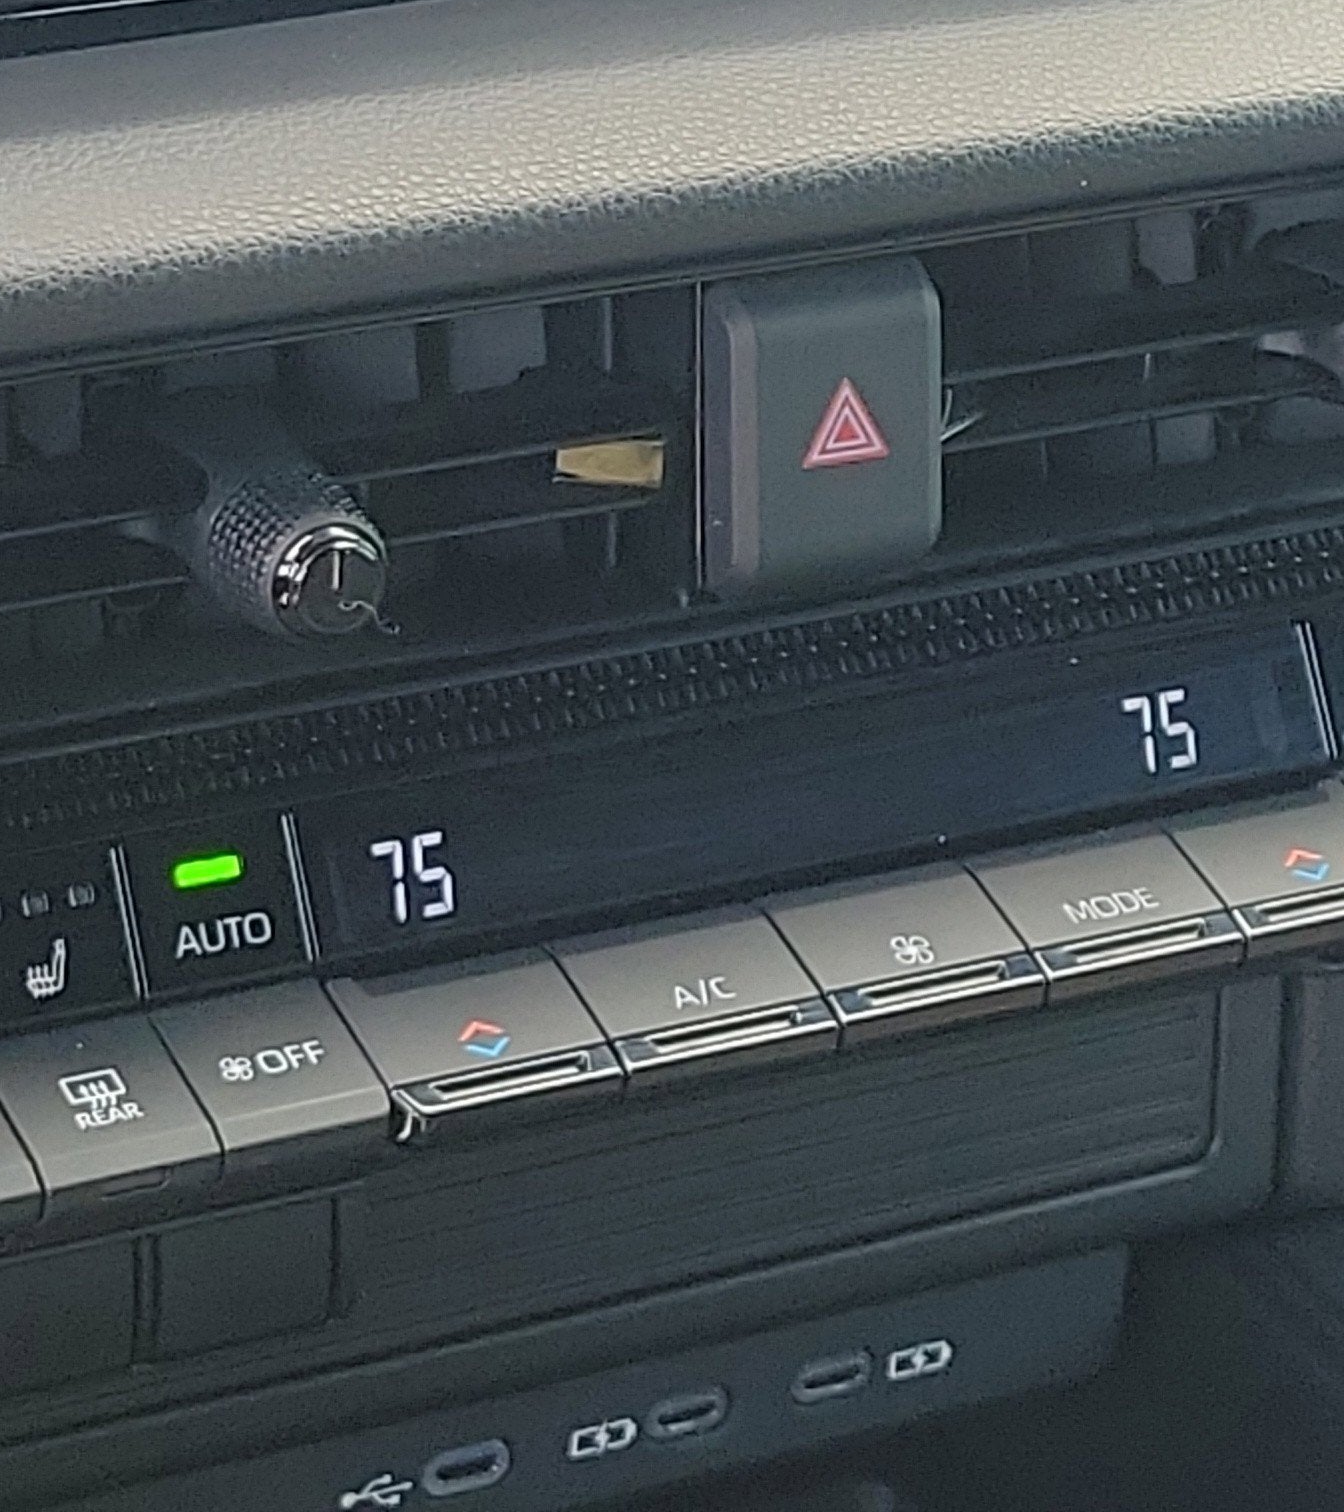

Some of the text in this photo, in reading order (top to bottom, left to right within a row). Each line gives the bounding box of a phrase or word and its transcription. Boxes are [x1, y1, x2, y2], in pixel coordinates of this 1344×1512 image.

[1121, 688, 1198, 773] 75
[371, 831, 454, 923] 75
[1062, 887, 1160, 924] MODE
[175, 911, 273, 958] AUTO
[673, 976, 736, 1010] A/C
[255, 1040, 325, 1074] OFF
[73, 1100, 146, 1130] REAR
